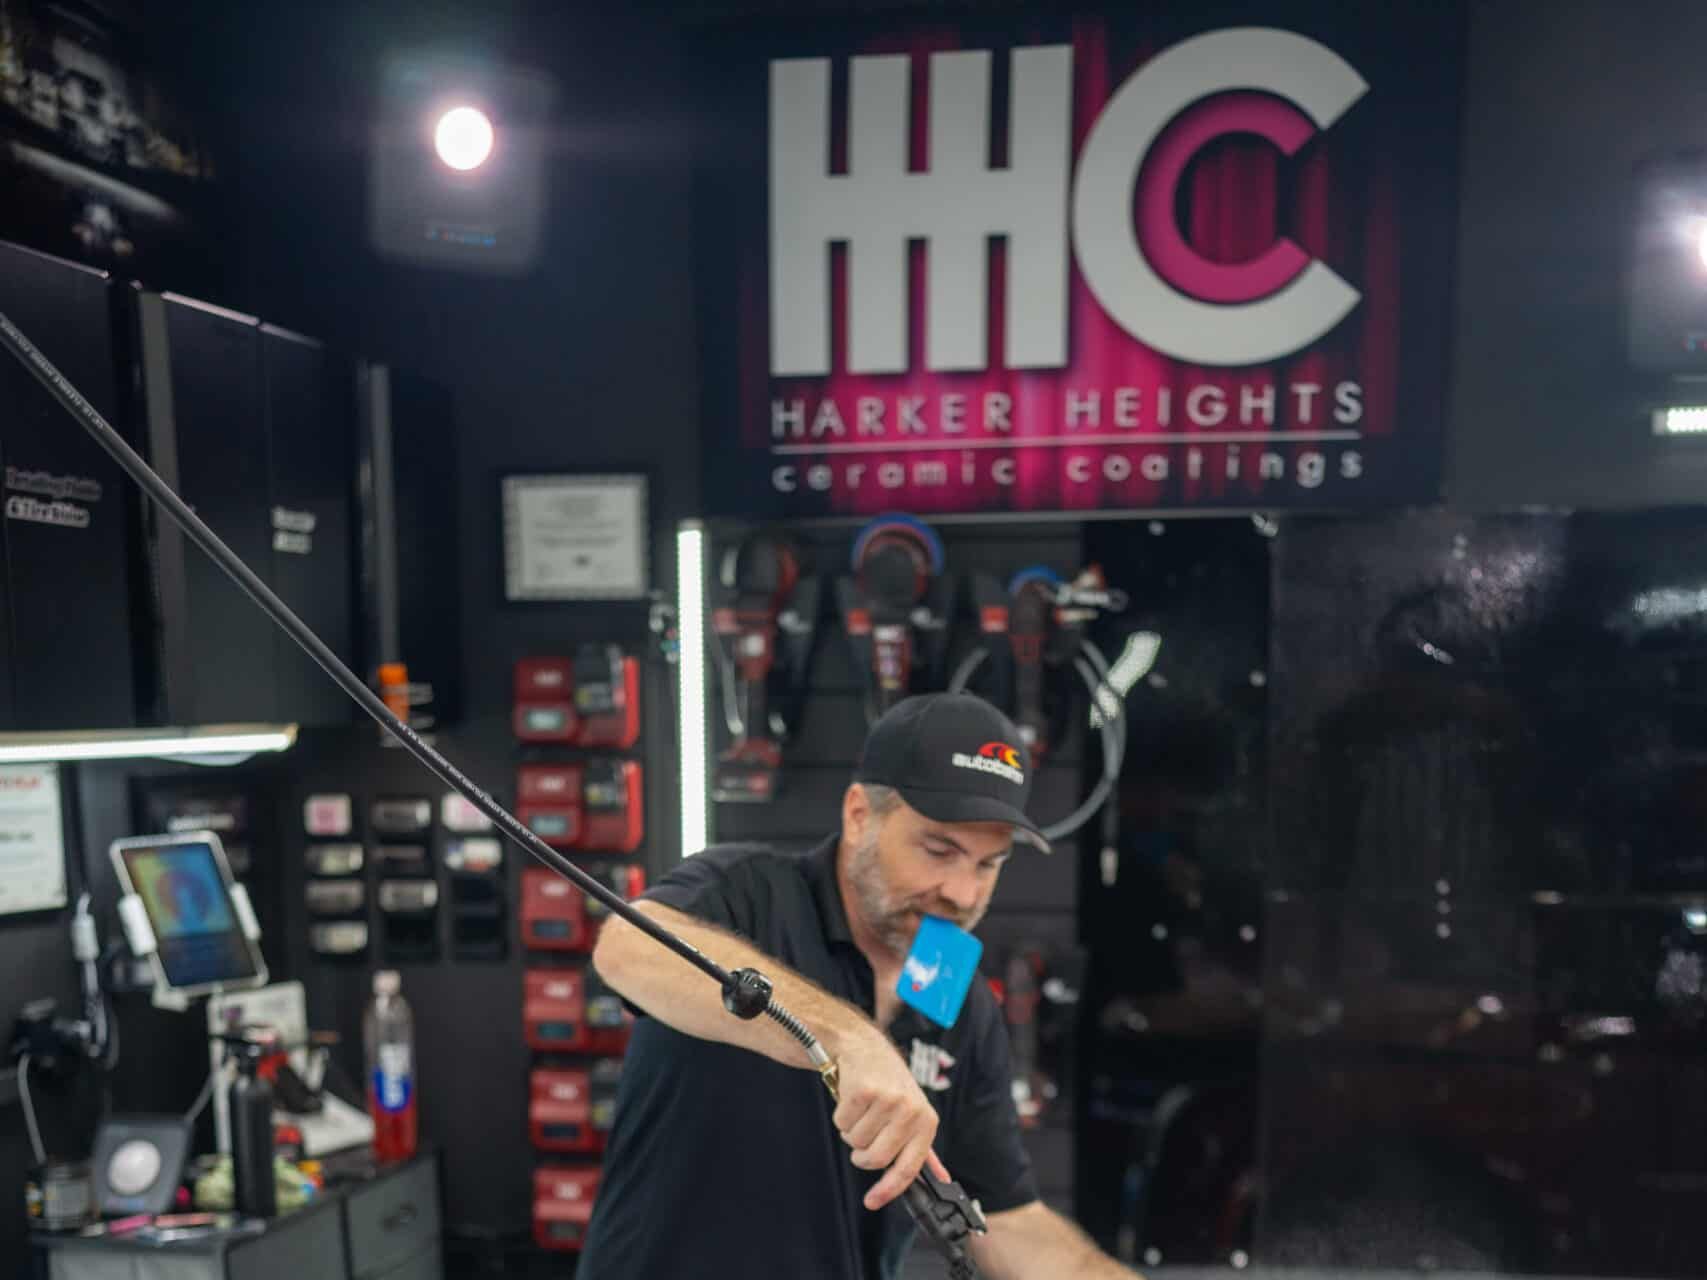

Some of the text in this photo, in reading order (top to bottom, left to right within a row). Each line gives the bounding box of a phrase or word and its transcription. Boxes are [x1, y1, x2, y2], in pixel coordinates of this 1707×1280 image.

[771, 381, 1363, 438] HARKER HEIGHTS
[771, 443, 1363, 492] ceramic coatings
